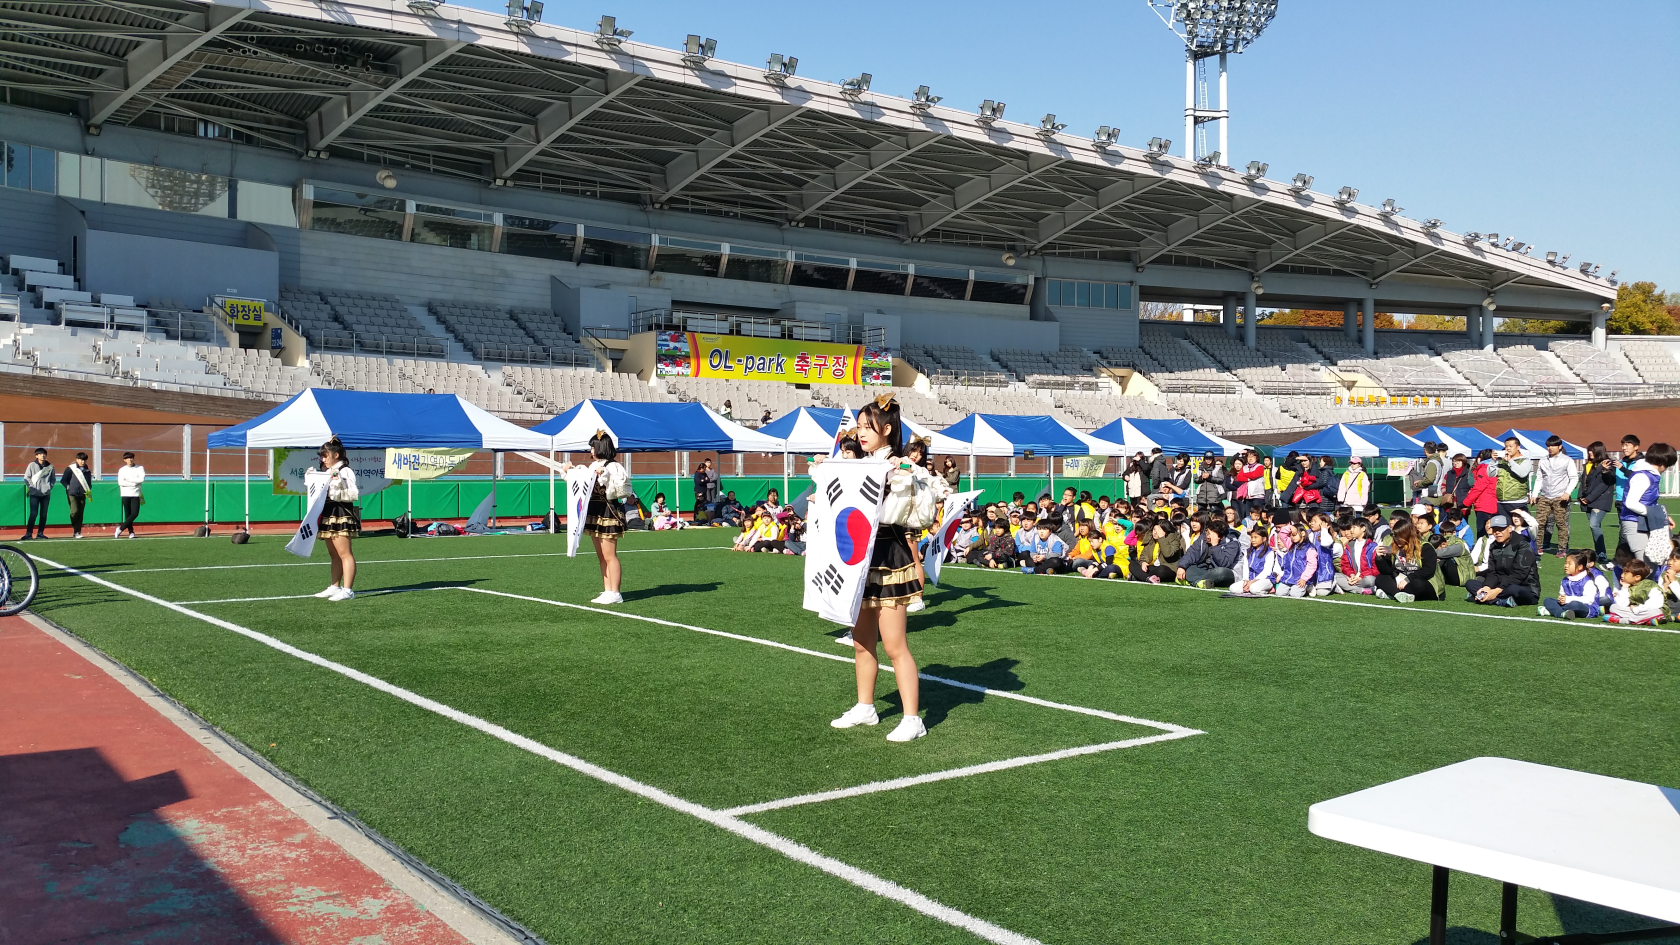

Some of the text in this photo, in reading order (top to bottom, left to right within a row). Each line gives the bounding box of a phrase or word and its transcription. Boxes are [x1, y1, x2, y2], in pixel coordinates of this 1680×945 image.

[228, 303, 263, 322] 화장실
[708, 347, 848, 378] OL-park 축구장
